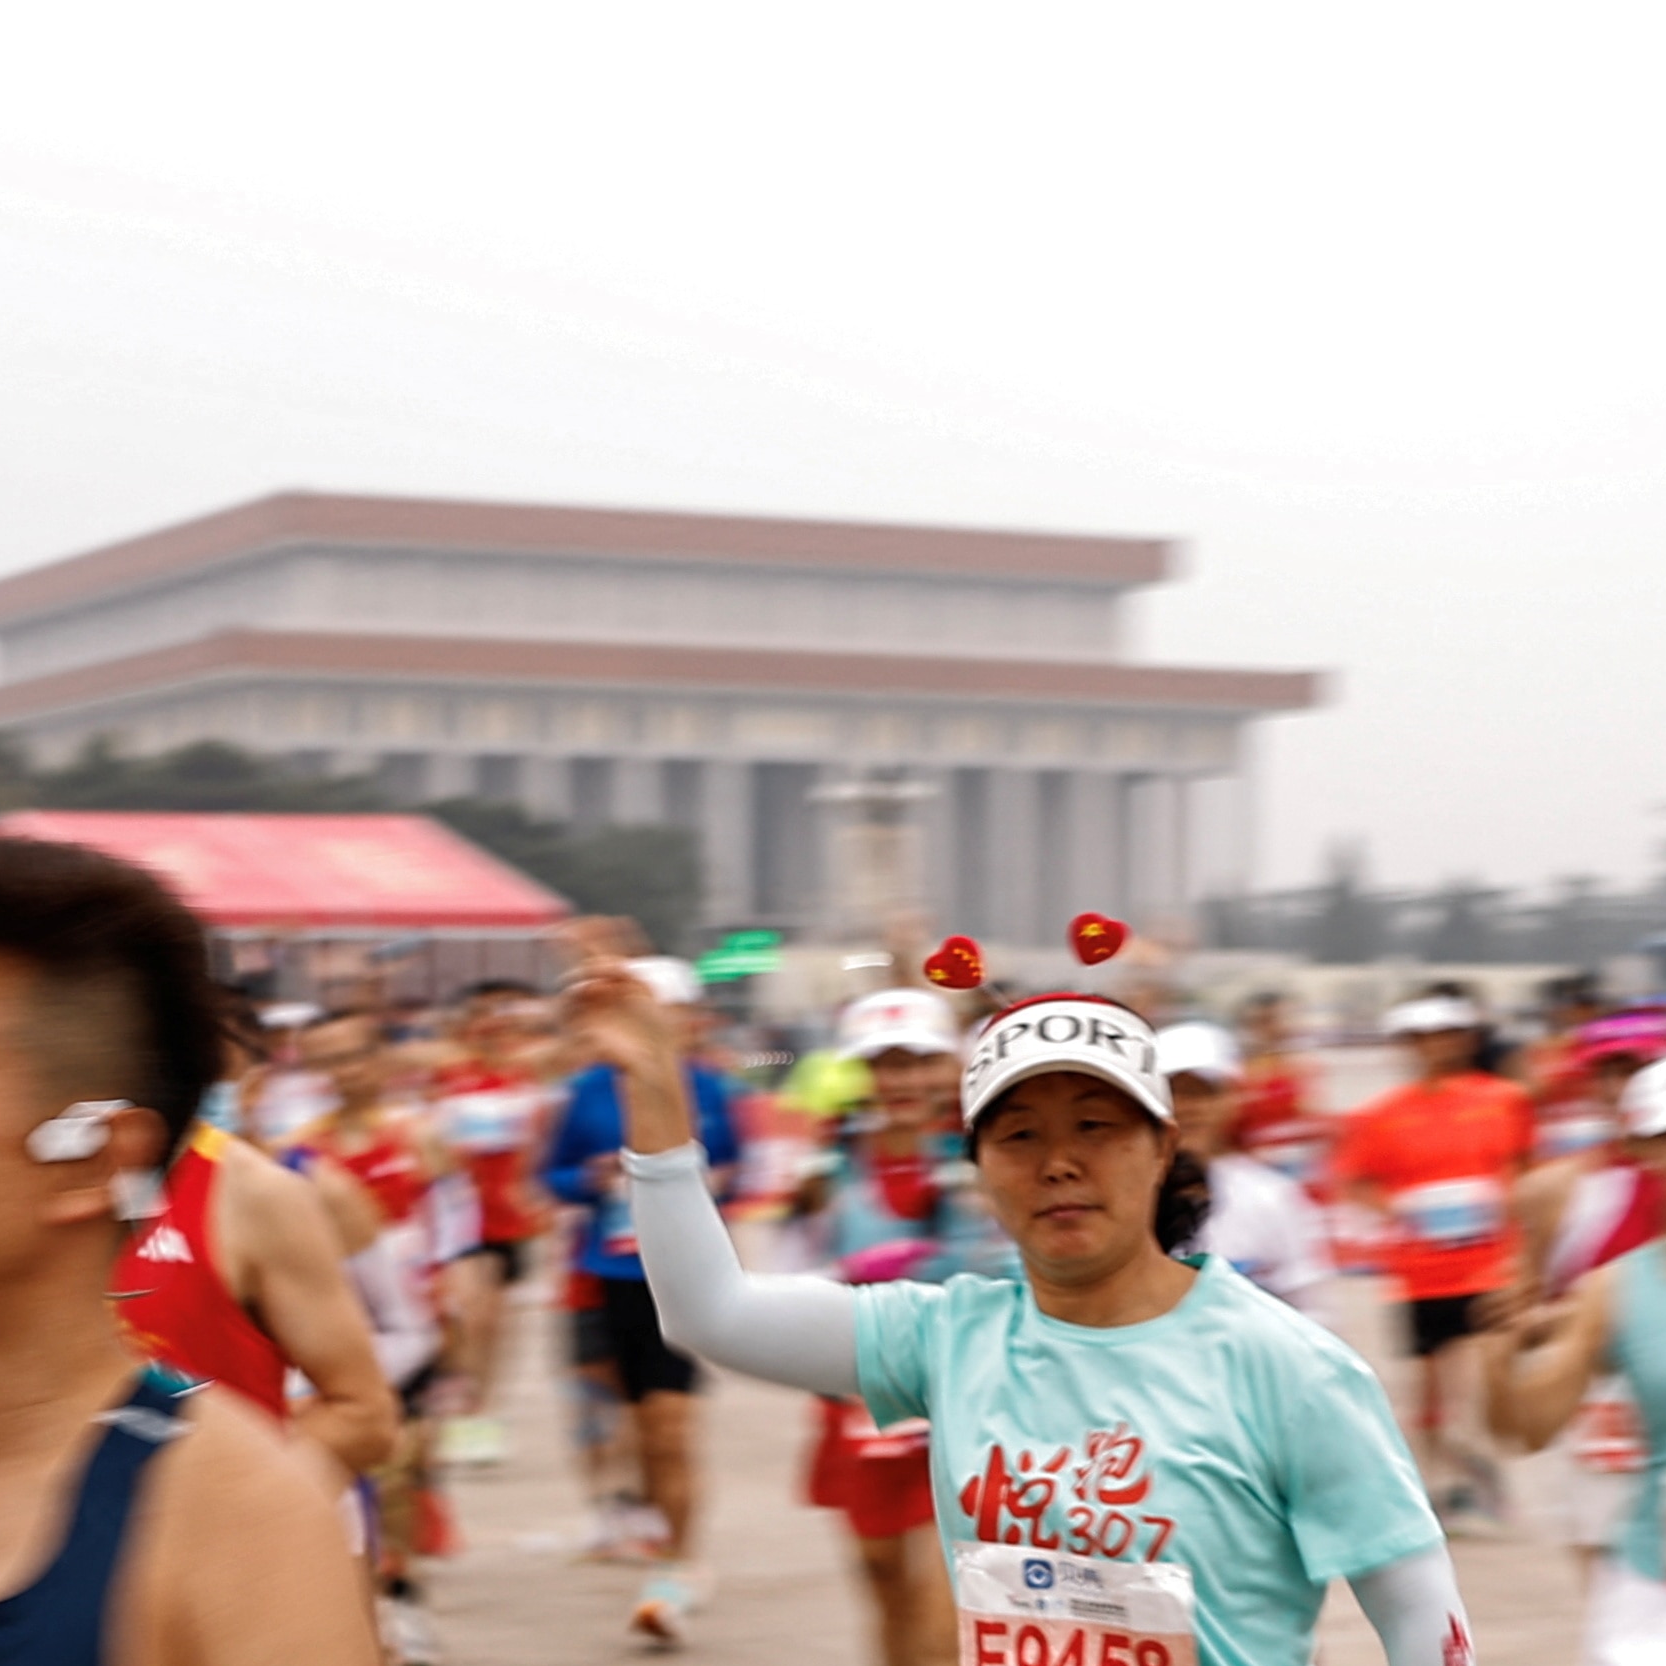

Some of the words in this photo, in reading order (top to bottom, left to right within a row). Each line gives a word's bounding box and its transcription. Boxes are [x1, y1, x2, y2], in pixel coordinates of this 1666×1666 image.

[966, 1013, 1157, 1088] SPORT
[959, 1421, 1152, 1551] 悦跑
[1066, 1504, 1177, 1563] 307
